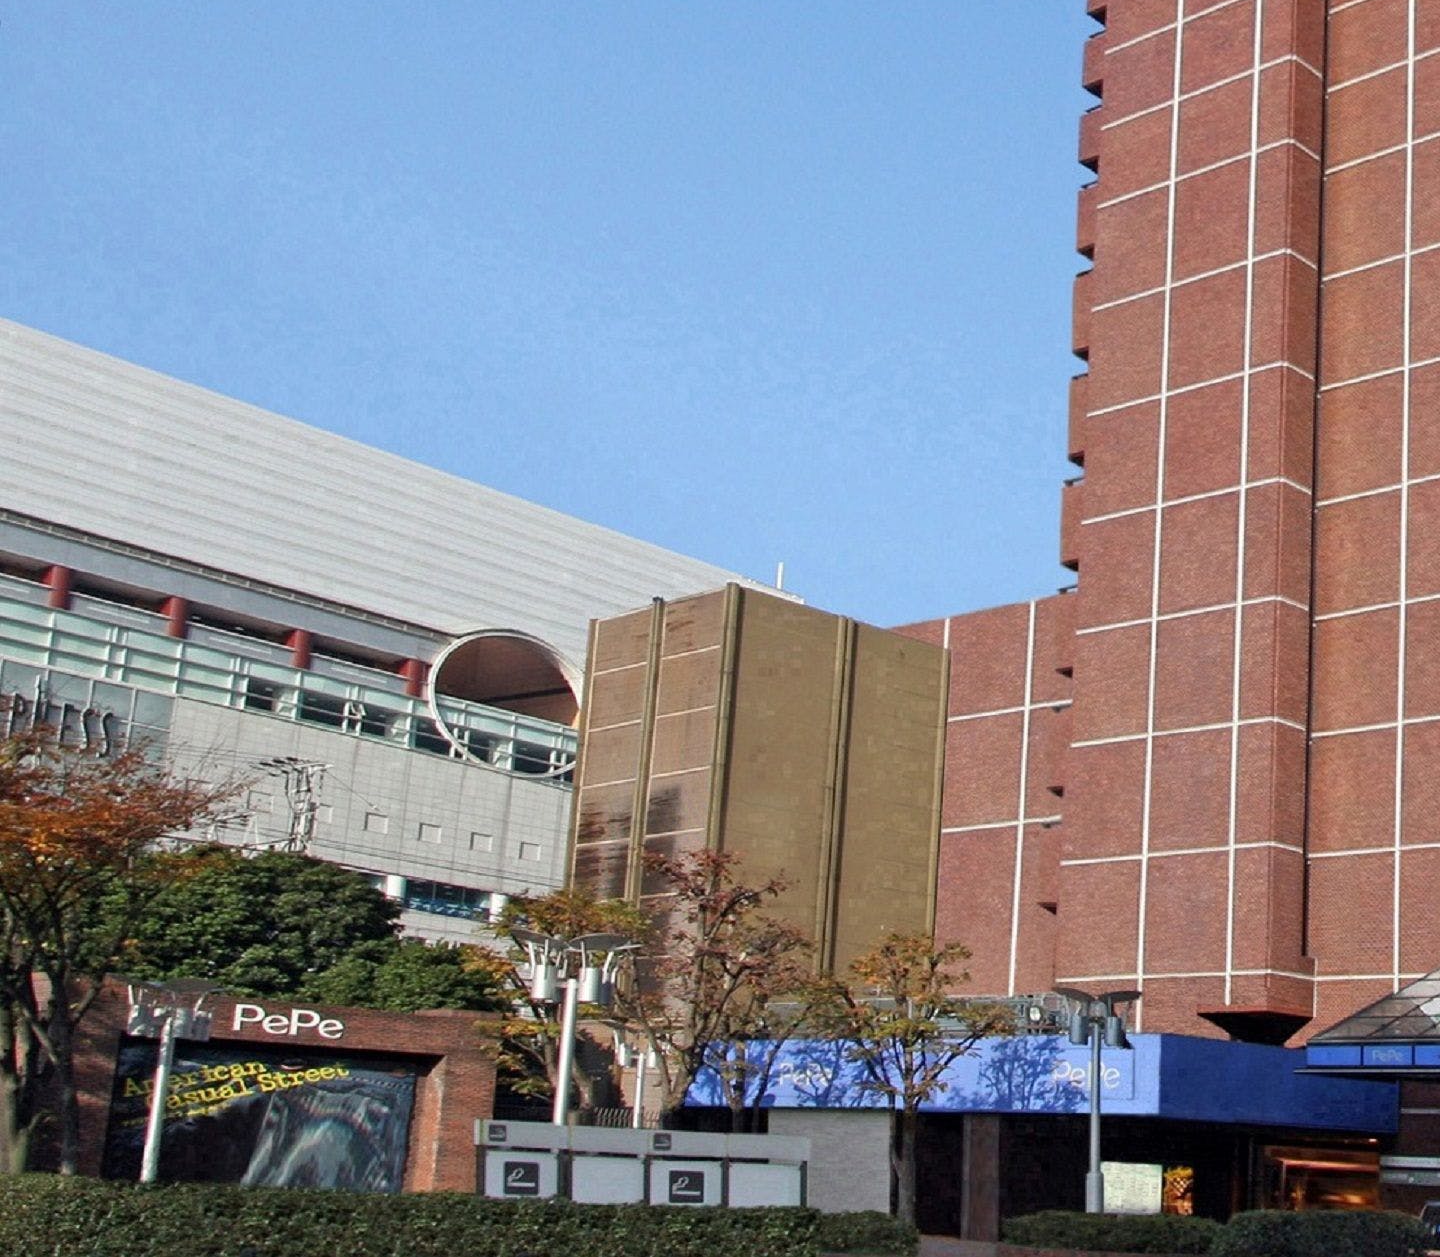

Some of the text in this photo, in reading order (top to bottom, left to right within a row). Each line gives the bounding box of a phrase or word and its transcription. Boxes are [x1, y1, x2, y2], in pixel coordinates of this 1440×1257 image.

[232, 1003, 344, 1039] PePe
[1372, 1049, 1404, 1062] PePe
[124, 1060, 266, 1097] Aerican
[258, 1062, 349, 1092] Street
